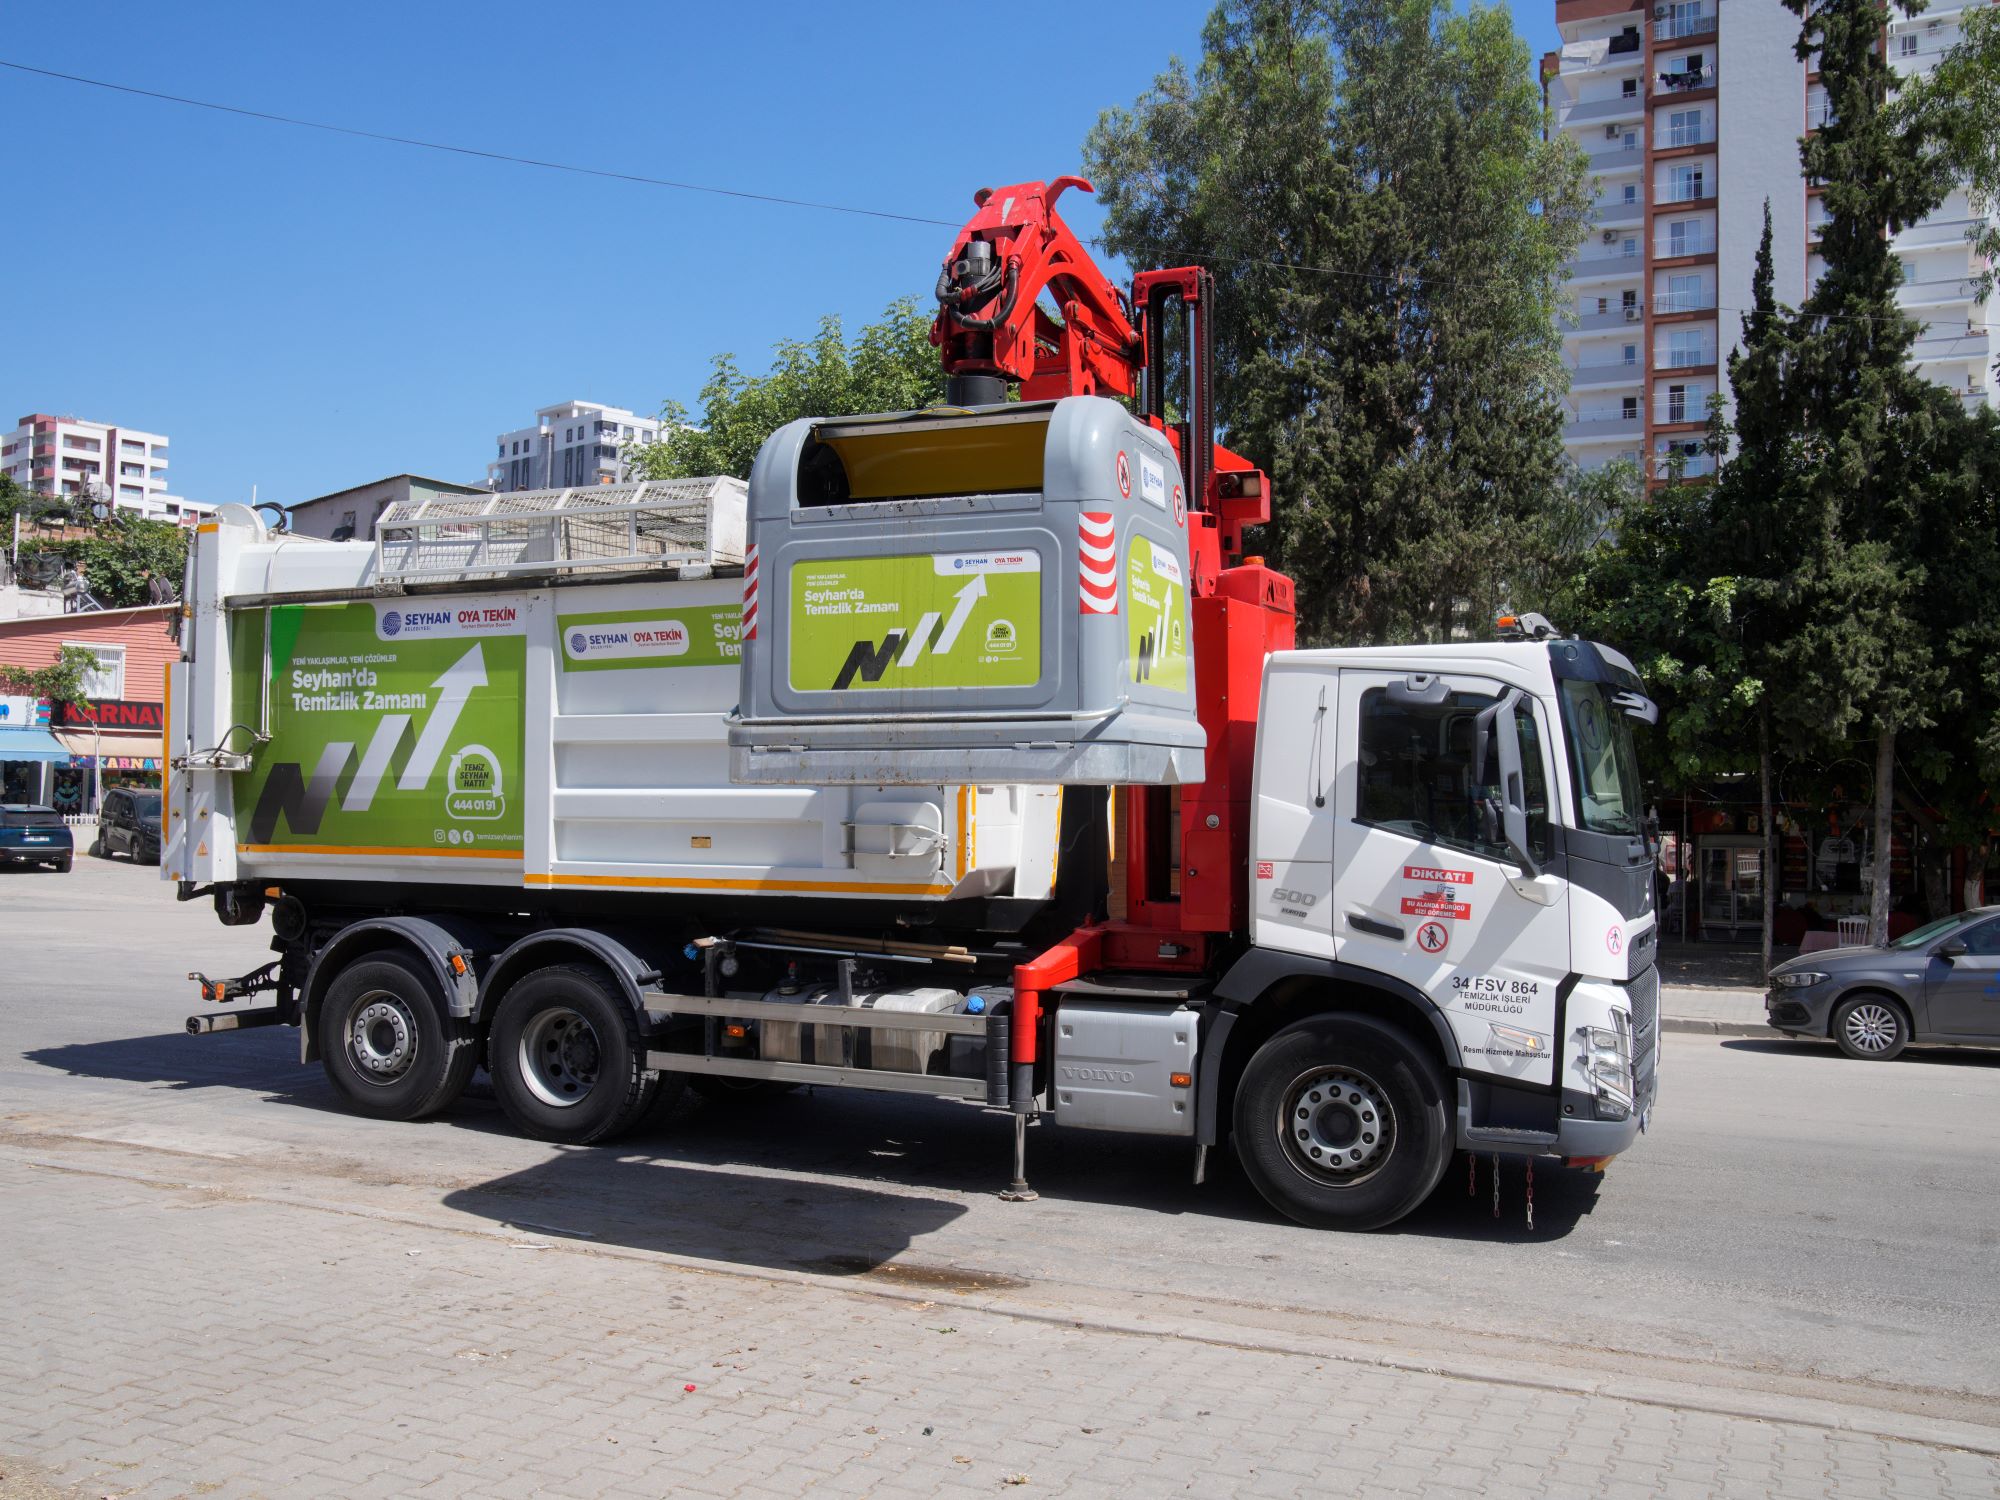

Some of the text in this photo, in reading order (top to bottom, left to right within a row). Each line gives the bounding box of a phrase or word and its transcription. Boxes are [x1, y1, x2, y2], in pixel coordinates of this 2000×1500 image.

[804, 588, 864, 603] Seyhan'da
[405, 606, 516, 625] SEYHAN OYA TEKİN
[804, 602, 899, 616] Temizlik Zamanı
[590, 634, 628, 644] SEYHAN
[634, 632, 653, 642] OYA
[654, 629, 682, 641] TEKİN
[714, 622, 742, 640] Sey
[292, 656, 306, 665] YENİ
[350, 655, 364, 664] YENİ
[365, 654, 397, 664] ÇÖZÜMLER
[292, 667, 377, 691] Seyhan'da
[292, 691, 426, 711] Temizlik Zamanı
[454, 800, 496, 810] 444 01 91
[1272, 888, 1316, 906] 500
[1428, 909, 1456, 917] GÖREMEZ
[1441, 903, 1465, 911] SÜRÜCÜ
[1452, 976, 1538, 994] 34 FSV 864
[1460, 991, 1531, 1004] TEMİZLİK İŞLERİ
[1465, 1002, 1523, 1014] MÜDÜRLÜĞÜ
[1463, 1046, 1550, 1059] Resmi Hizmete Mahsustur
[1061, 1066, 1135, 1083] VOLVO
